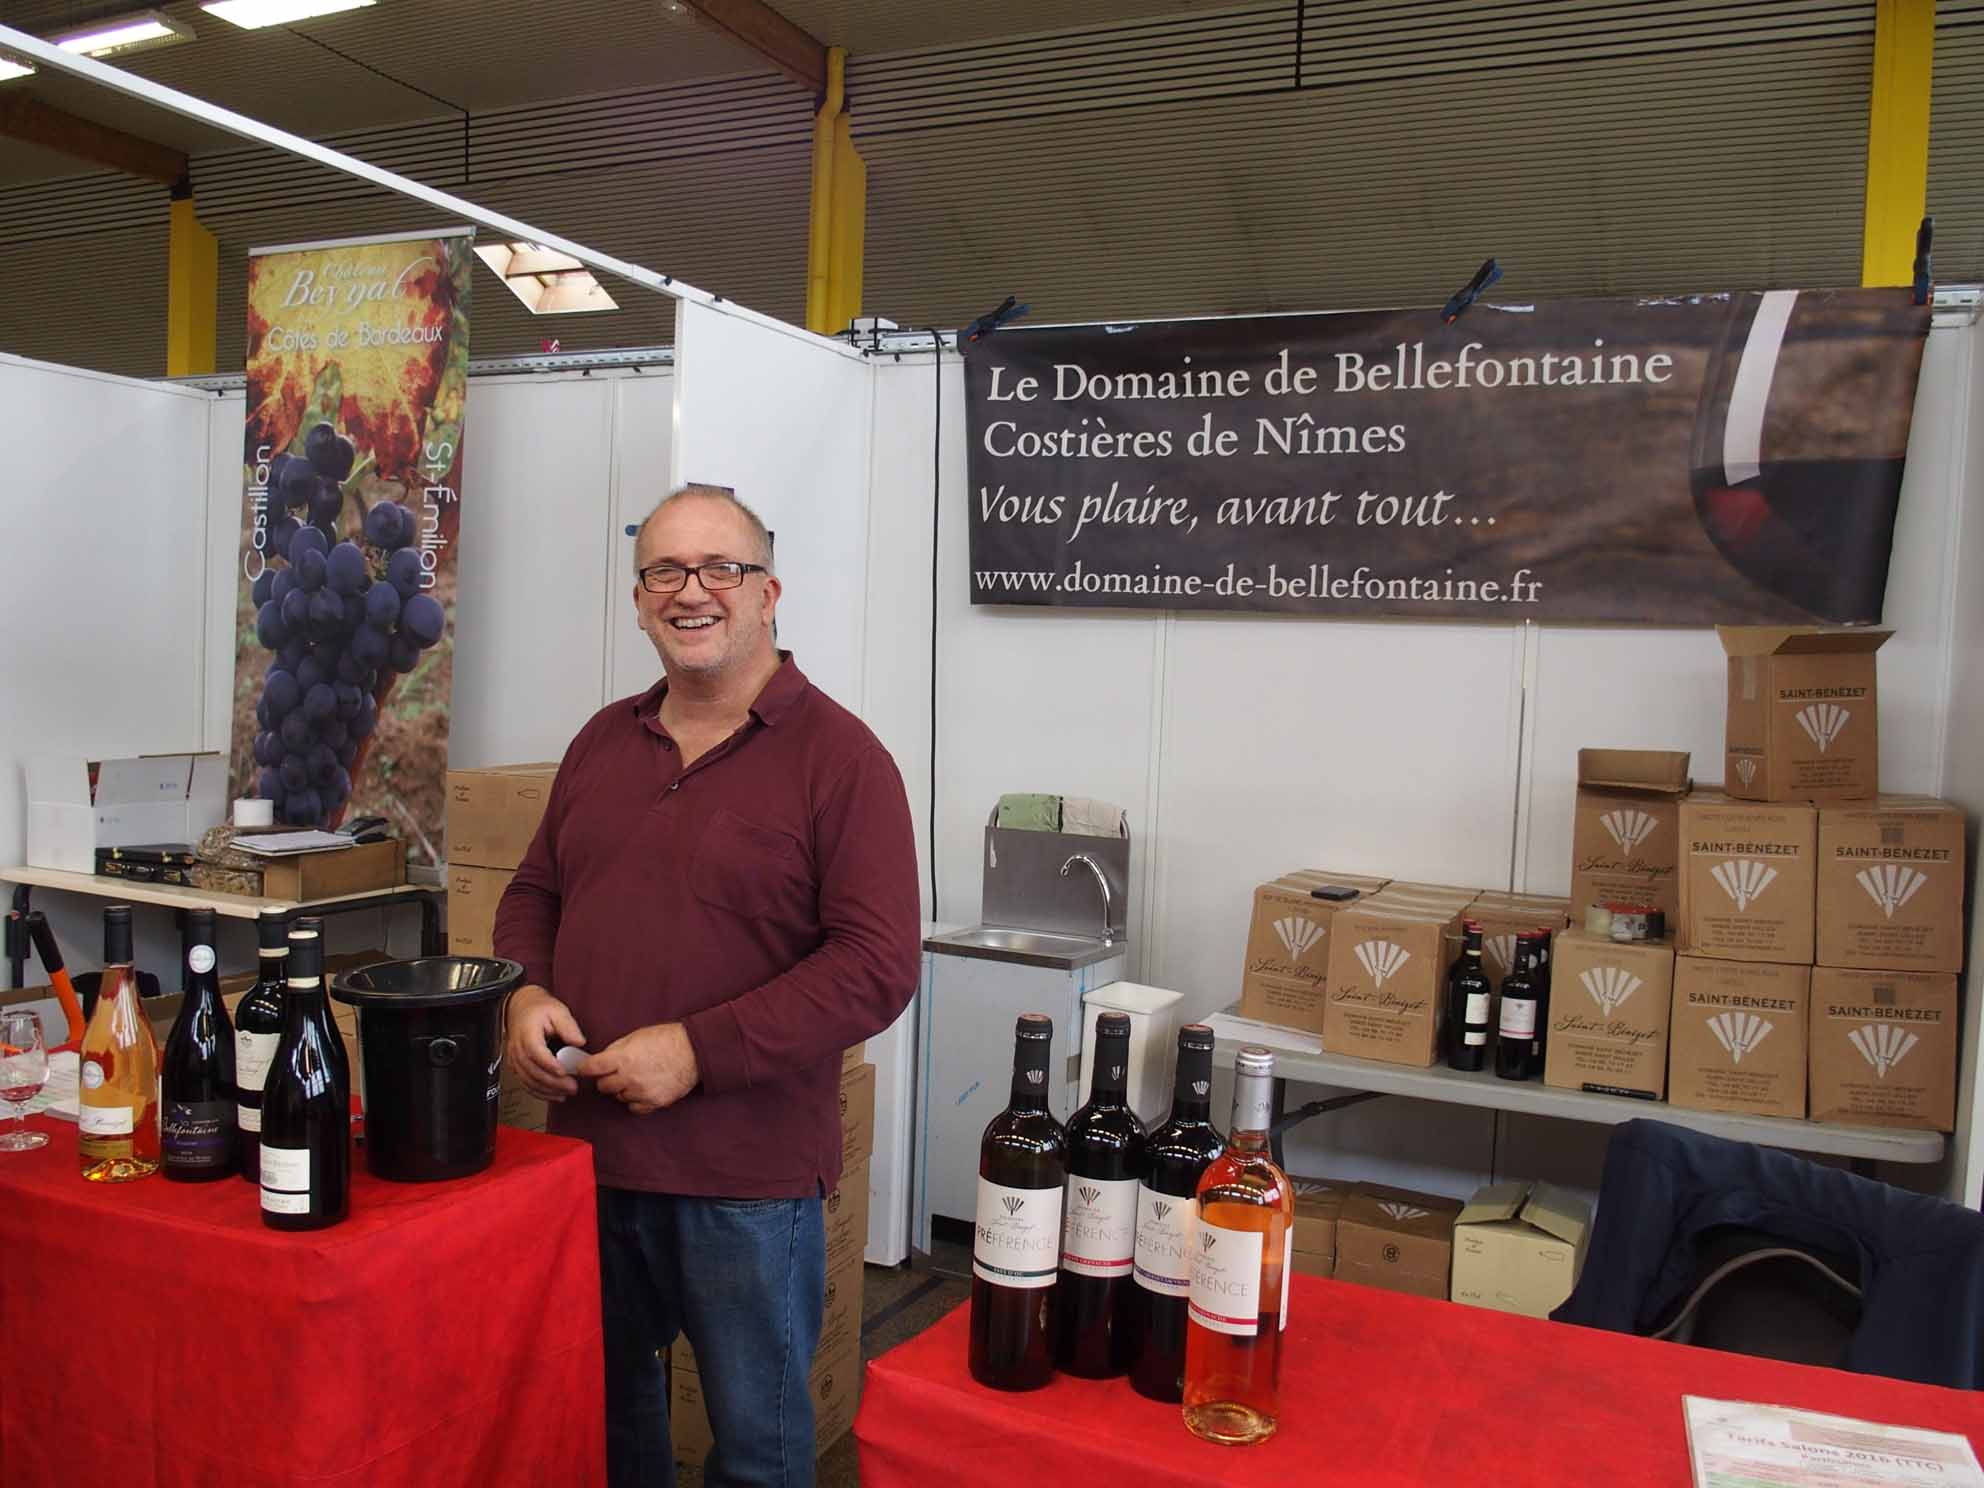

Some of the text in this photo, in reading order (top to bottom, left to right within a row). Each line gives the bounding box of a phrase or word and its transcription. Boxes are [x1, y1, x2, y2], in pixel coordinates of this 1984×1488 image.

[327, 325, 349, 346] de
[359, 321, 444, 346] Bordeaux
[986, 339, 1674, 402] Le Domaine de Bellefontaine
[984, 412, 1406, 458] Costières de Nîmes
[244, 445, 272, 582] Castillon
[417, 441, 458, 589] St-Émilion
[978, 484, 1065, 526] Vous
[1066, 483, 1199, 544] plaire,
[1215, 487, 1340, 527] avant
[974, 561, 1543, 602] www.domaine-de-bellefontaine.fr
[1781, 1440, 1844, 1458] Salons
